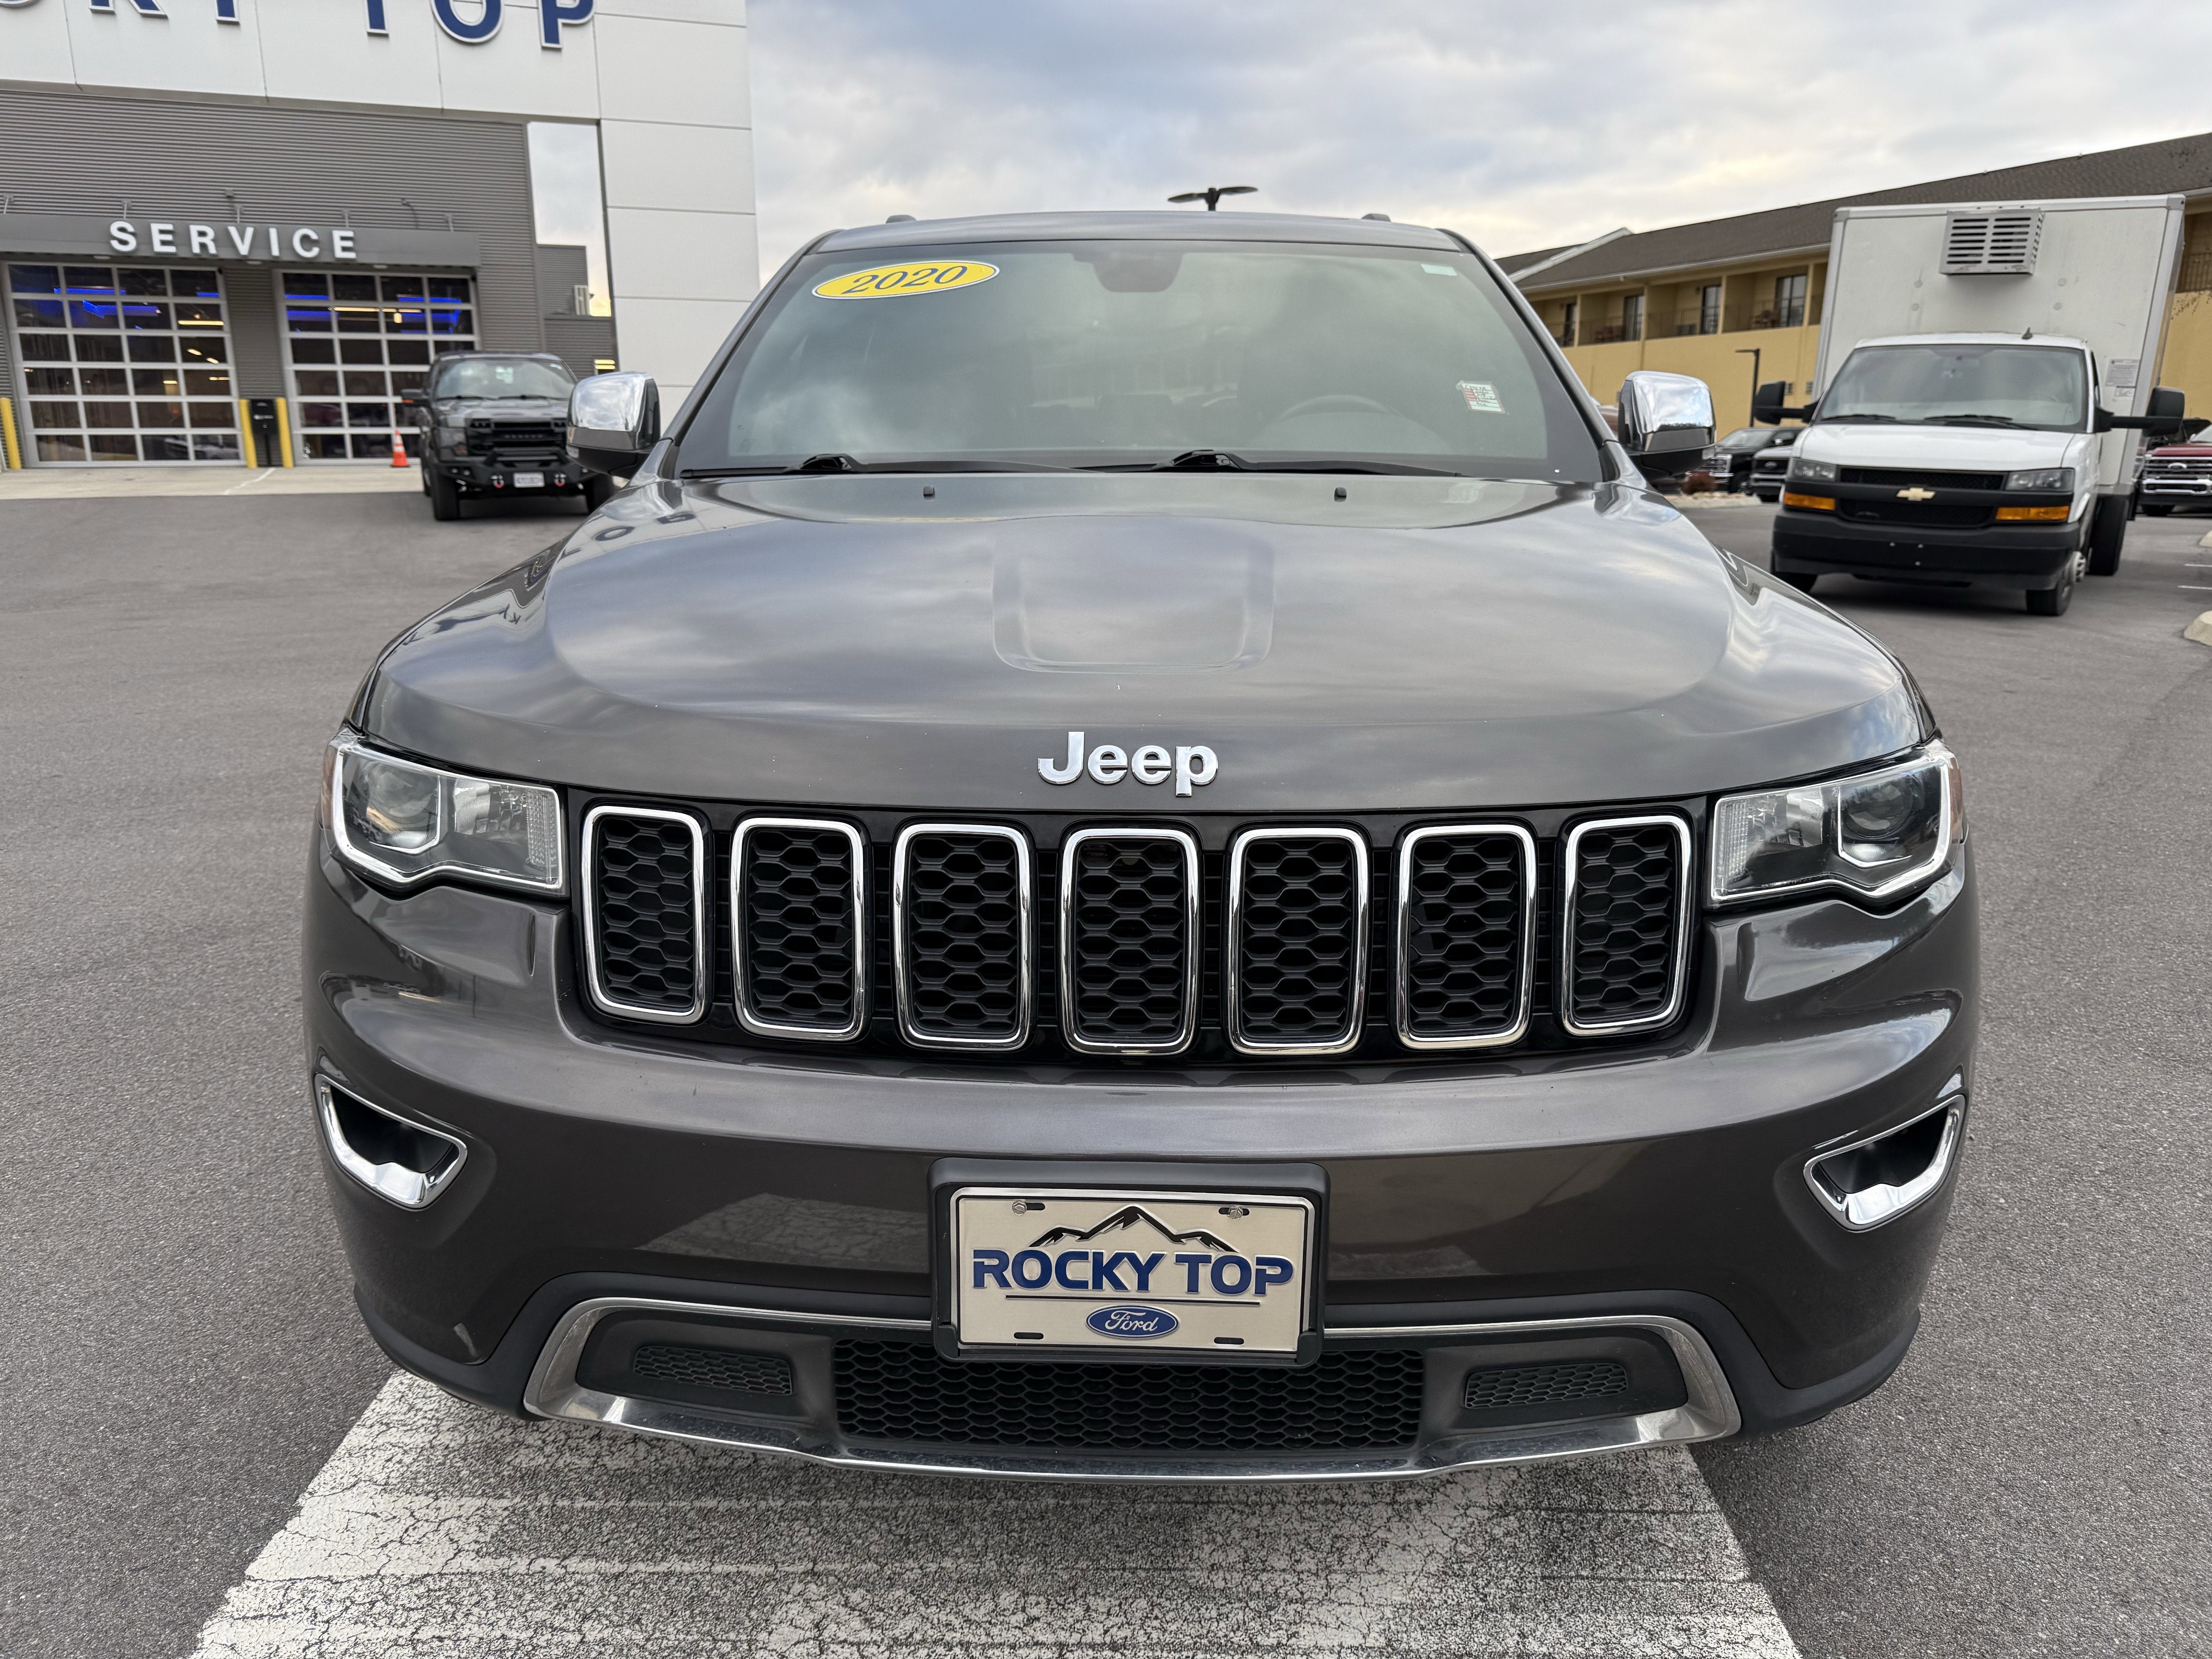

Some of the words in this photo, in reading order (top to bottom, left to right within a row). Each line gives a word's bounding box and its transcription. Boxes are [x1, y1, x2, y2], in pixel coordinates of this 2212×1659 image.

[110, 221, 357, 259] SERVICE
[841, 266, 968, 295] 2020
[1038, 731, 1218, 797] Jeep
[973, 1249, 1166, 1292] ROCKY
[1174, 1252, 1294, 1295] TOP
[1104, 1310, 1159, 1332] Ford
